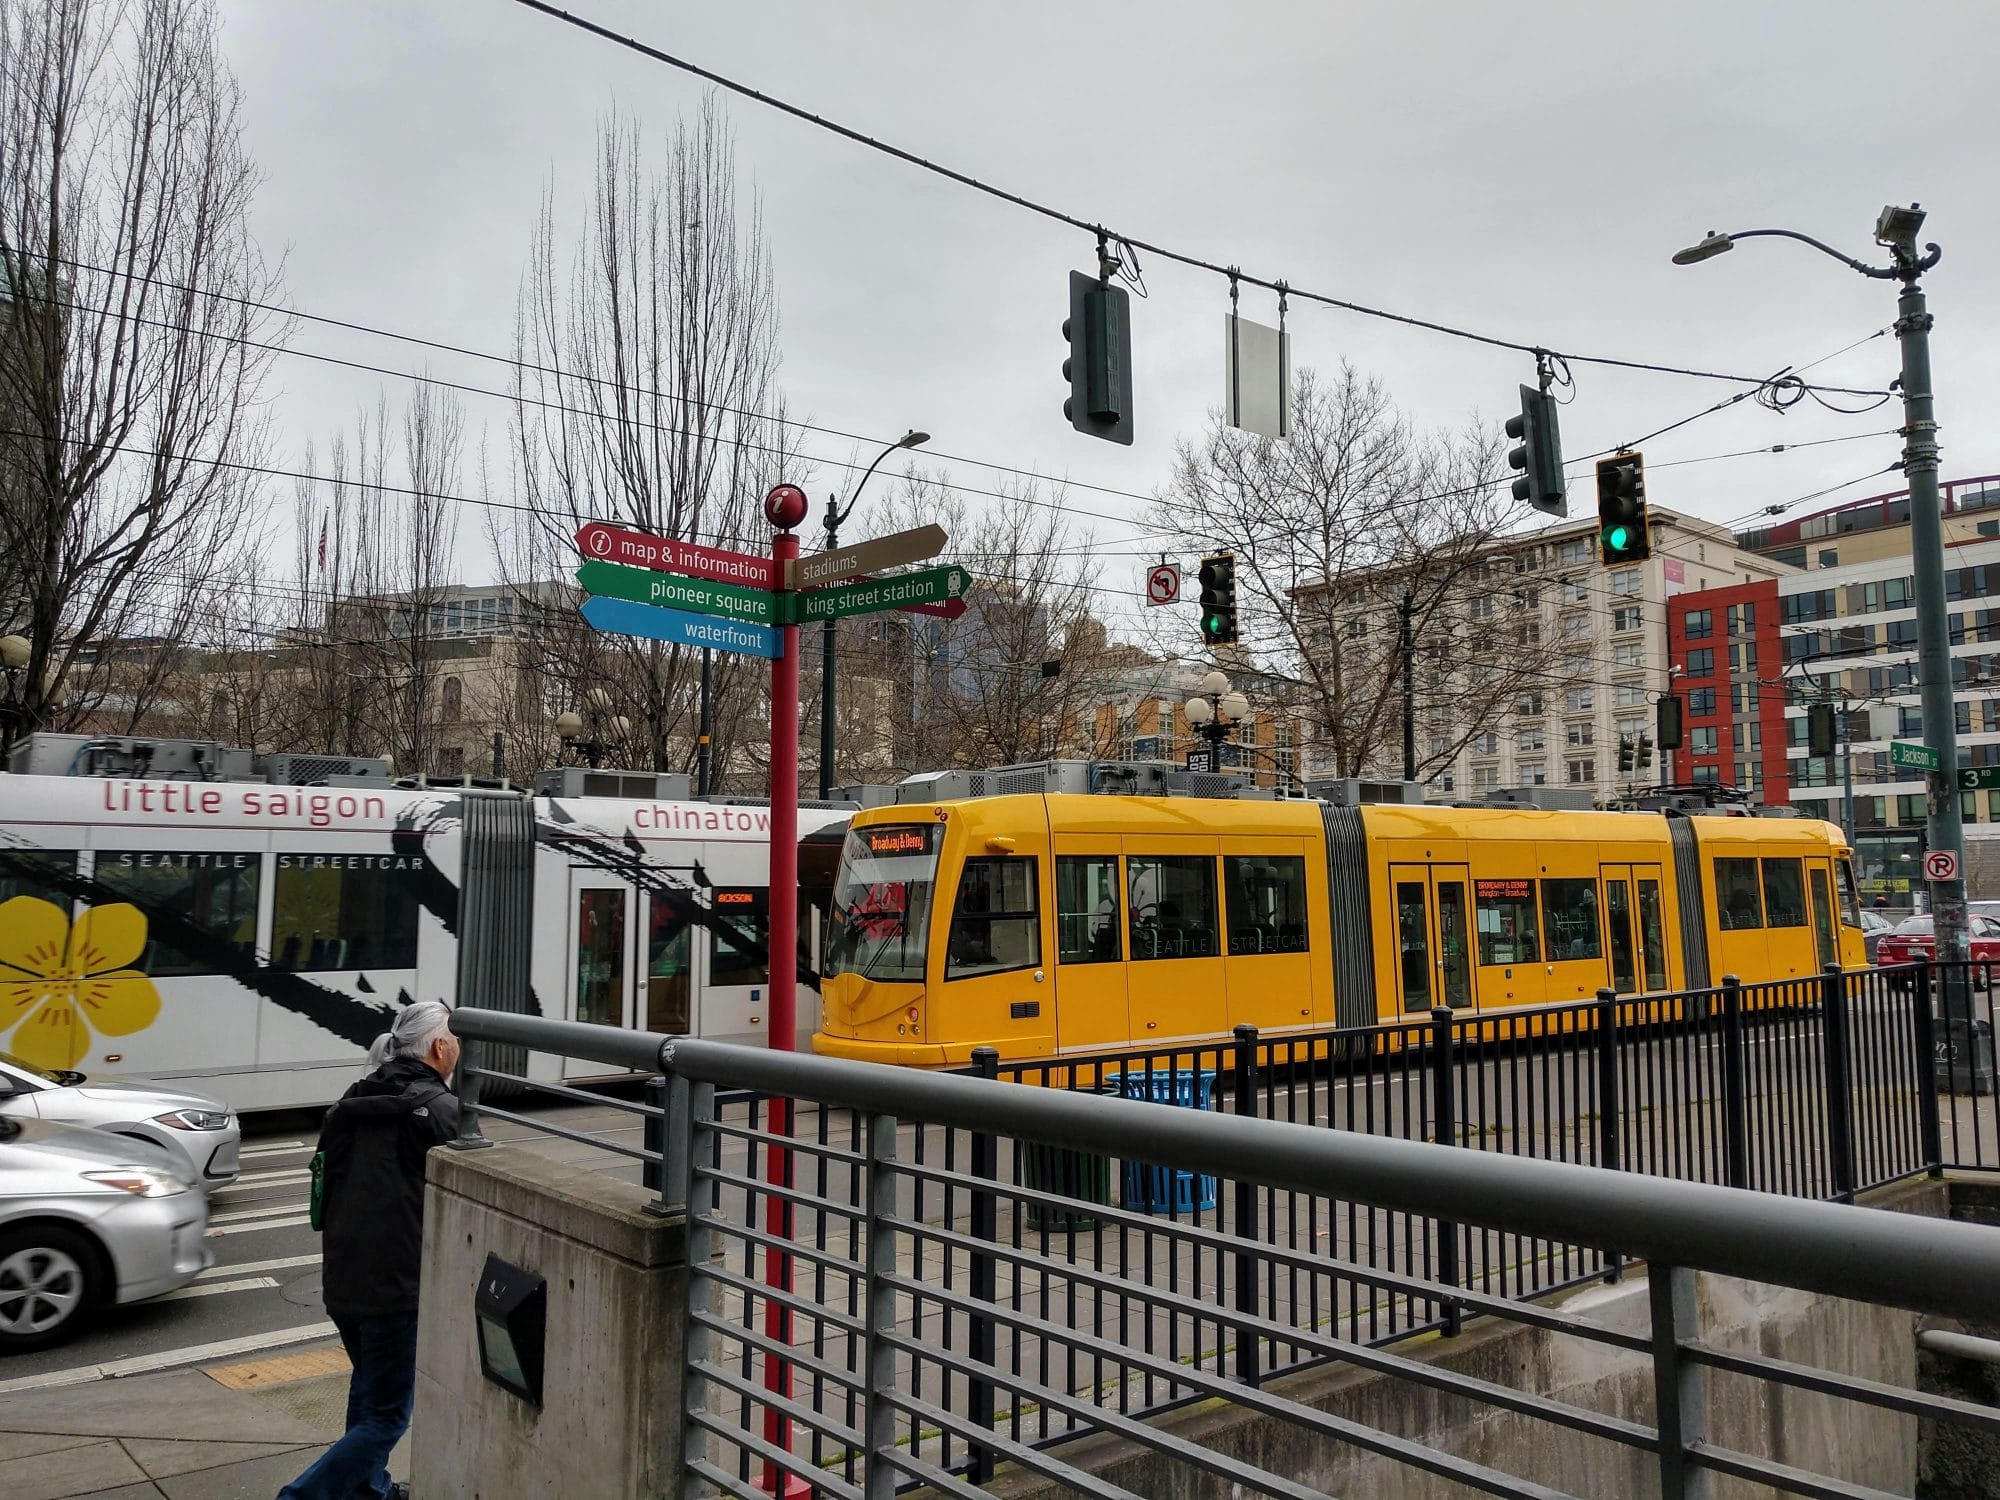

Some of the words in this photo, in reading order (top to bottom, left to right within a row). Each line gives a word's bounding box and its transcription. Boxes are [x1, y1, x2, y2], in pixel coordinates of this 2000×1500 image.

[621, 540, 657, 563] map
[661, 546, 674, 564] &
[679, 548, 767, 581] information
[803, 555, 857, 580] stadiums
[651, 580, 712, 605] pioneer
[715, 594, 766, 615] square
[806, 596, 835, 615] king
[838, 588, 879, 610] street
[883, 580, 934, 602] station
[685, 623, 762, 649] waterfront
[1892, 749, 1897, 760] S
[1901, 745, 1929, 765] Jackson
[103, 781, 222, 814] little
[243, 789, 385, 826] saigon
[634, 804, 771, 831] chinatow
[871, 835, 900, 852] Broadway
[906, 833, 924, 850] Denny
[120, 854, 246, 868] SEATTLE
[279, 855, 424, 870] STREETCAR
[1145, 938, 1208, 955] SEATTLE
[1231, 934, 1306, 951] STREETCAR
